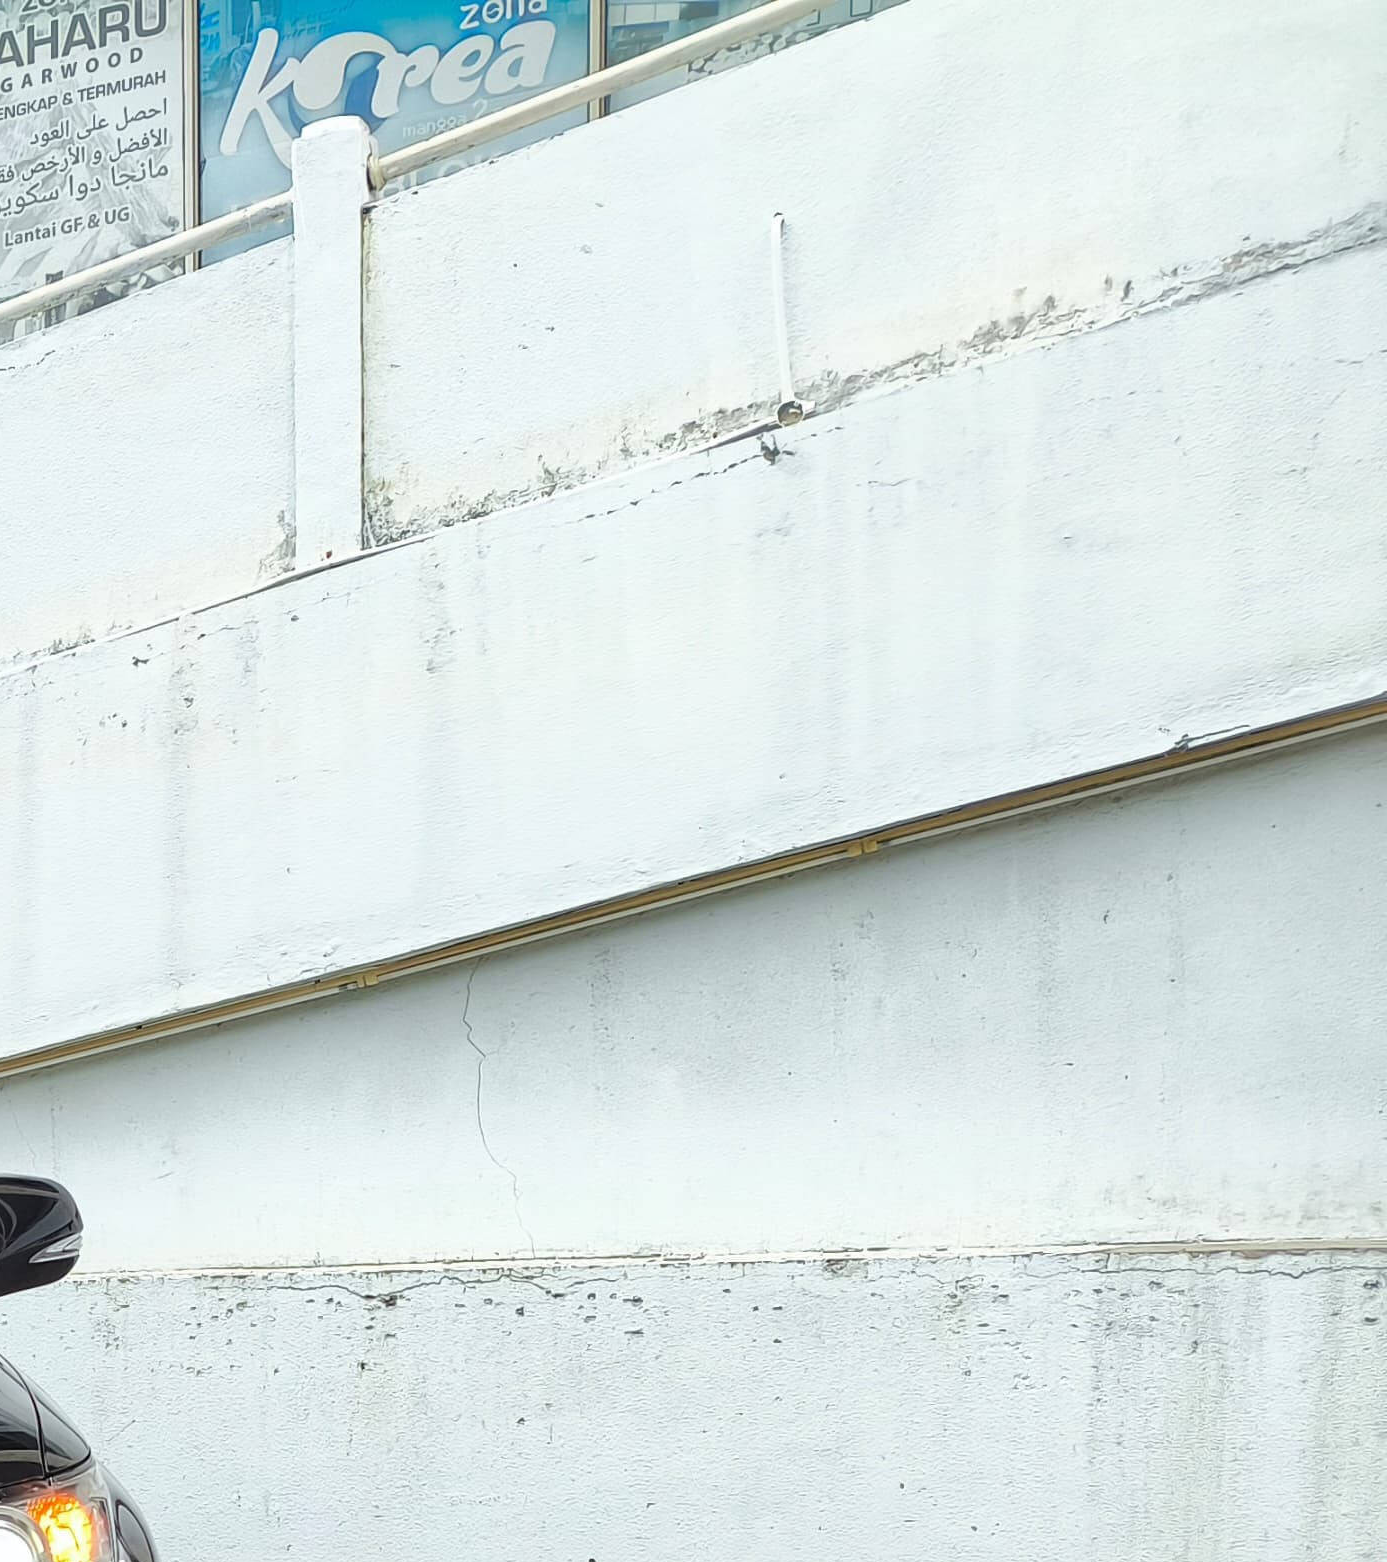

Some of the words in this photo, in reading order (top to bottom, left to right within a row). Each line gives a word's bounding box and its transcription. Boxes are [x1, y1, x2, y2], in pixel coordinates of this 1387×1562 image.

[62, 92, 74, 105] &
[77, 70, 166, 102] TERMURAH
[76, 114, 109, 140] على
[116, 97, 167, 131] احصل
[30, 120, 69, 147] العود
[92, 150, 102, 165] و
[69, 174, 101, 201] دوا
[111, 157, 169, 190] مانجا
[4, 222, 56, 247] Lantai
[61, 216, 84, 235] GF
[88, 213, 100, 228] &
[105, 206, 130, 225] UG
